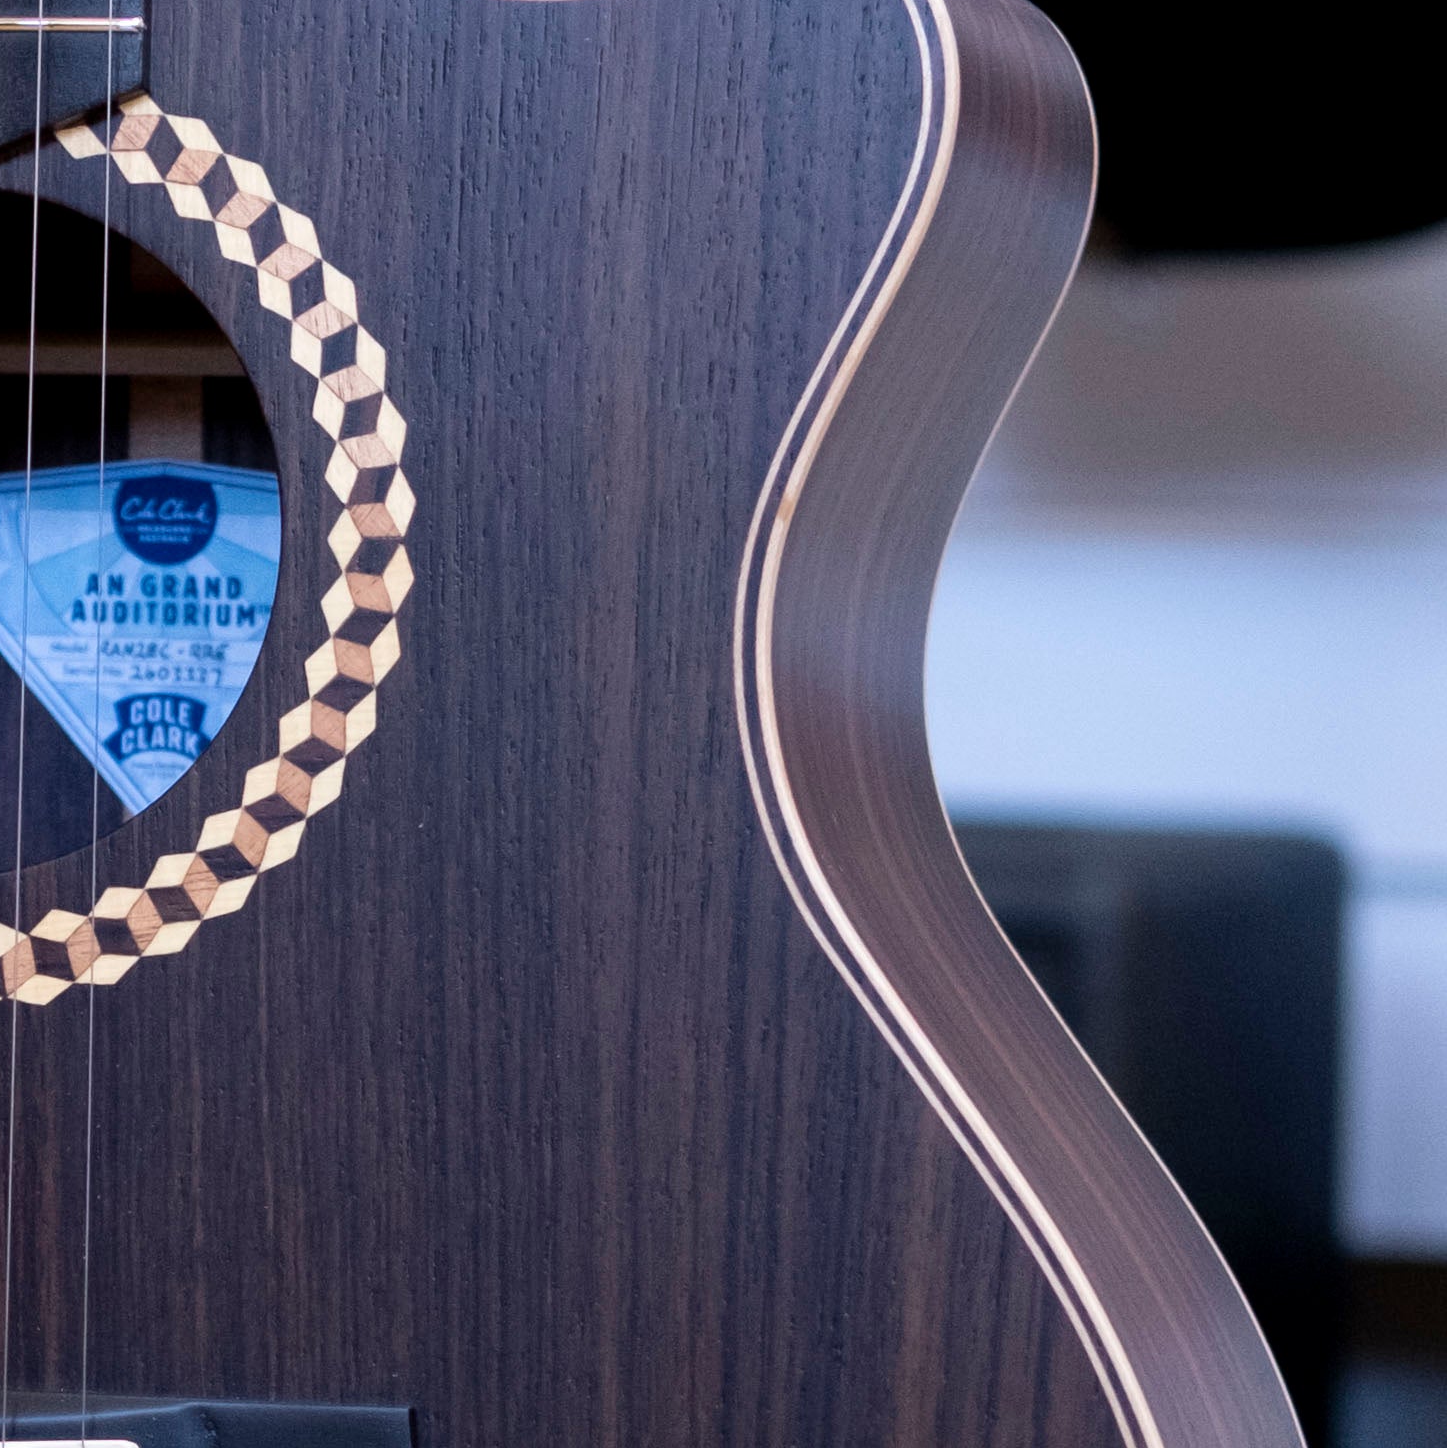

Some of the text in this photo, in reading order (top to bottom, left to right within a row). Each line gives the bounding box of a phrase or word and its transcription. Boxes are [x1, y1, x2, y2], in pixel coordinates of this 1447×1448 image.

[86, 573, 242, 600] AN GRAND
[130, 699, 192, 728] COLE
[121, 725, 200, 755] CLARK
